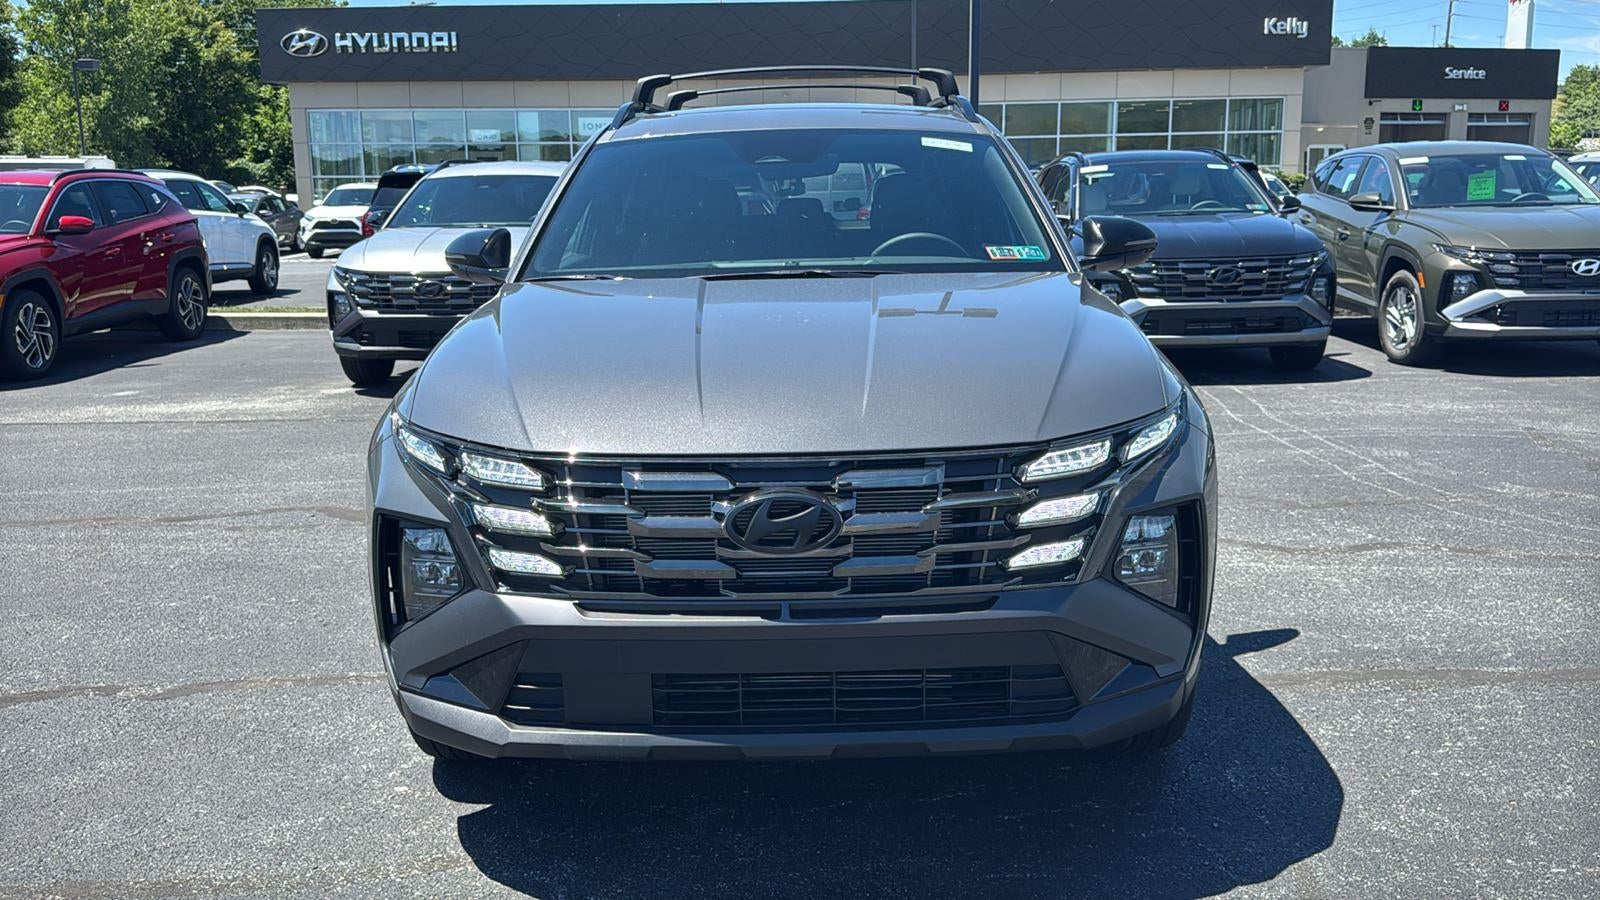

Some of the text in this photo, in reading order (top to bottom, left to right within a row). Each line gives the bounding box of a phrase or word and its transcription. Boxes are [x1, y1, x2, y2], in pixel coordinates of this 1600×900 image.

[1263, 17, 1309, 39] Kelly
[334, 31, 458, 54] HYUNDAI
[1444, 66, 1487, 80] Service
